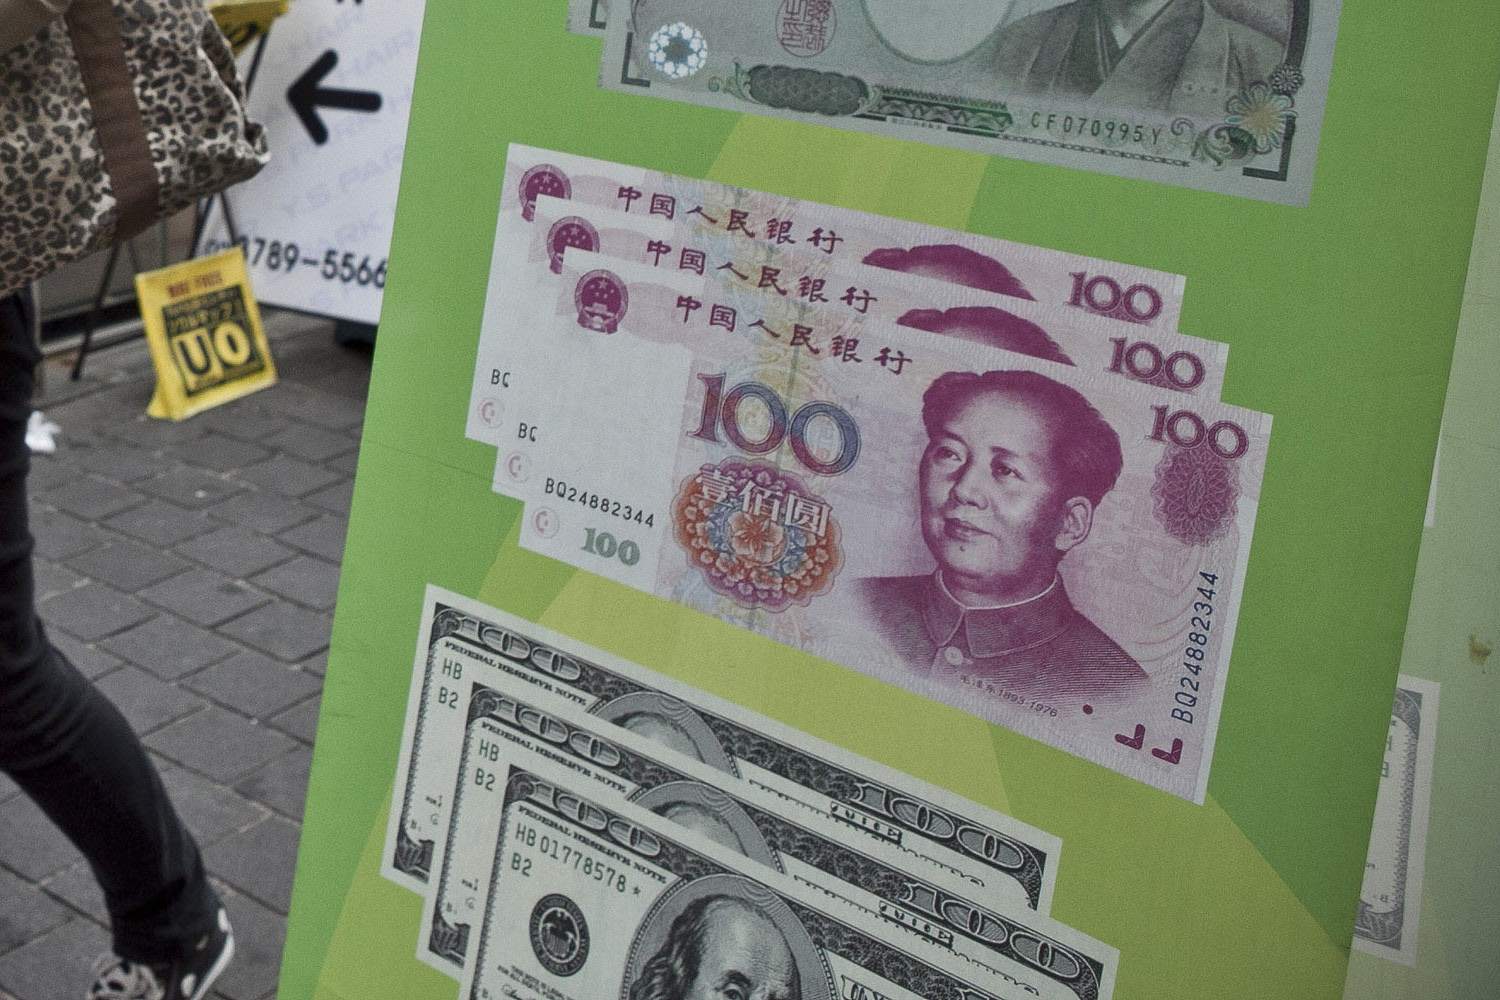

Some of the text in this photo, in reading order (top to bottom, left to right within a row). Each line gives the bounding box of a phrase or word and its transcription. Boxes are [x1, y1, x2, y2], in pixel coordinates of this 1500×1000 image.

[1030, 112, 1161, 145] CF070995Y
[617, 186, 844, 254] 中国人民银行
[647, 240, 878, 314] 中国人民银行
[1067, 270, 1163, 323] 100
[676, 296, 912, 375] 中国人民银行
[1104, 336, 1206, 391] 100
[686, 372, 861, 477] 100
[1146, 403, 1250, 461] 100
[545, 477, 654, 528] BQ24882344
[580, 527, 640, 566] 100
[443, 658, 462, 680] HB
[445, 641, 496, 667] FEDERAL
[452, 616, 582, 681] 100
[1171, 571, 1219, 725] BQ24882344
[439, 687, 457, 709] B2
[479, 739, 499, 761] HB
[482, 722, 533, 750] FEDERAL
[489, 697, 621, 768] 100
[475, 769, 495, 791] B2
[518, 805, 571, 836] FEDERAL
[526, 781, 661, 857] 100
[853, 783, 1023, 869] 100
[512, 853, 532, 877] B2
[903, 882, 1079, 978] 100
